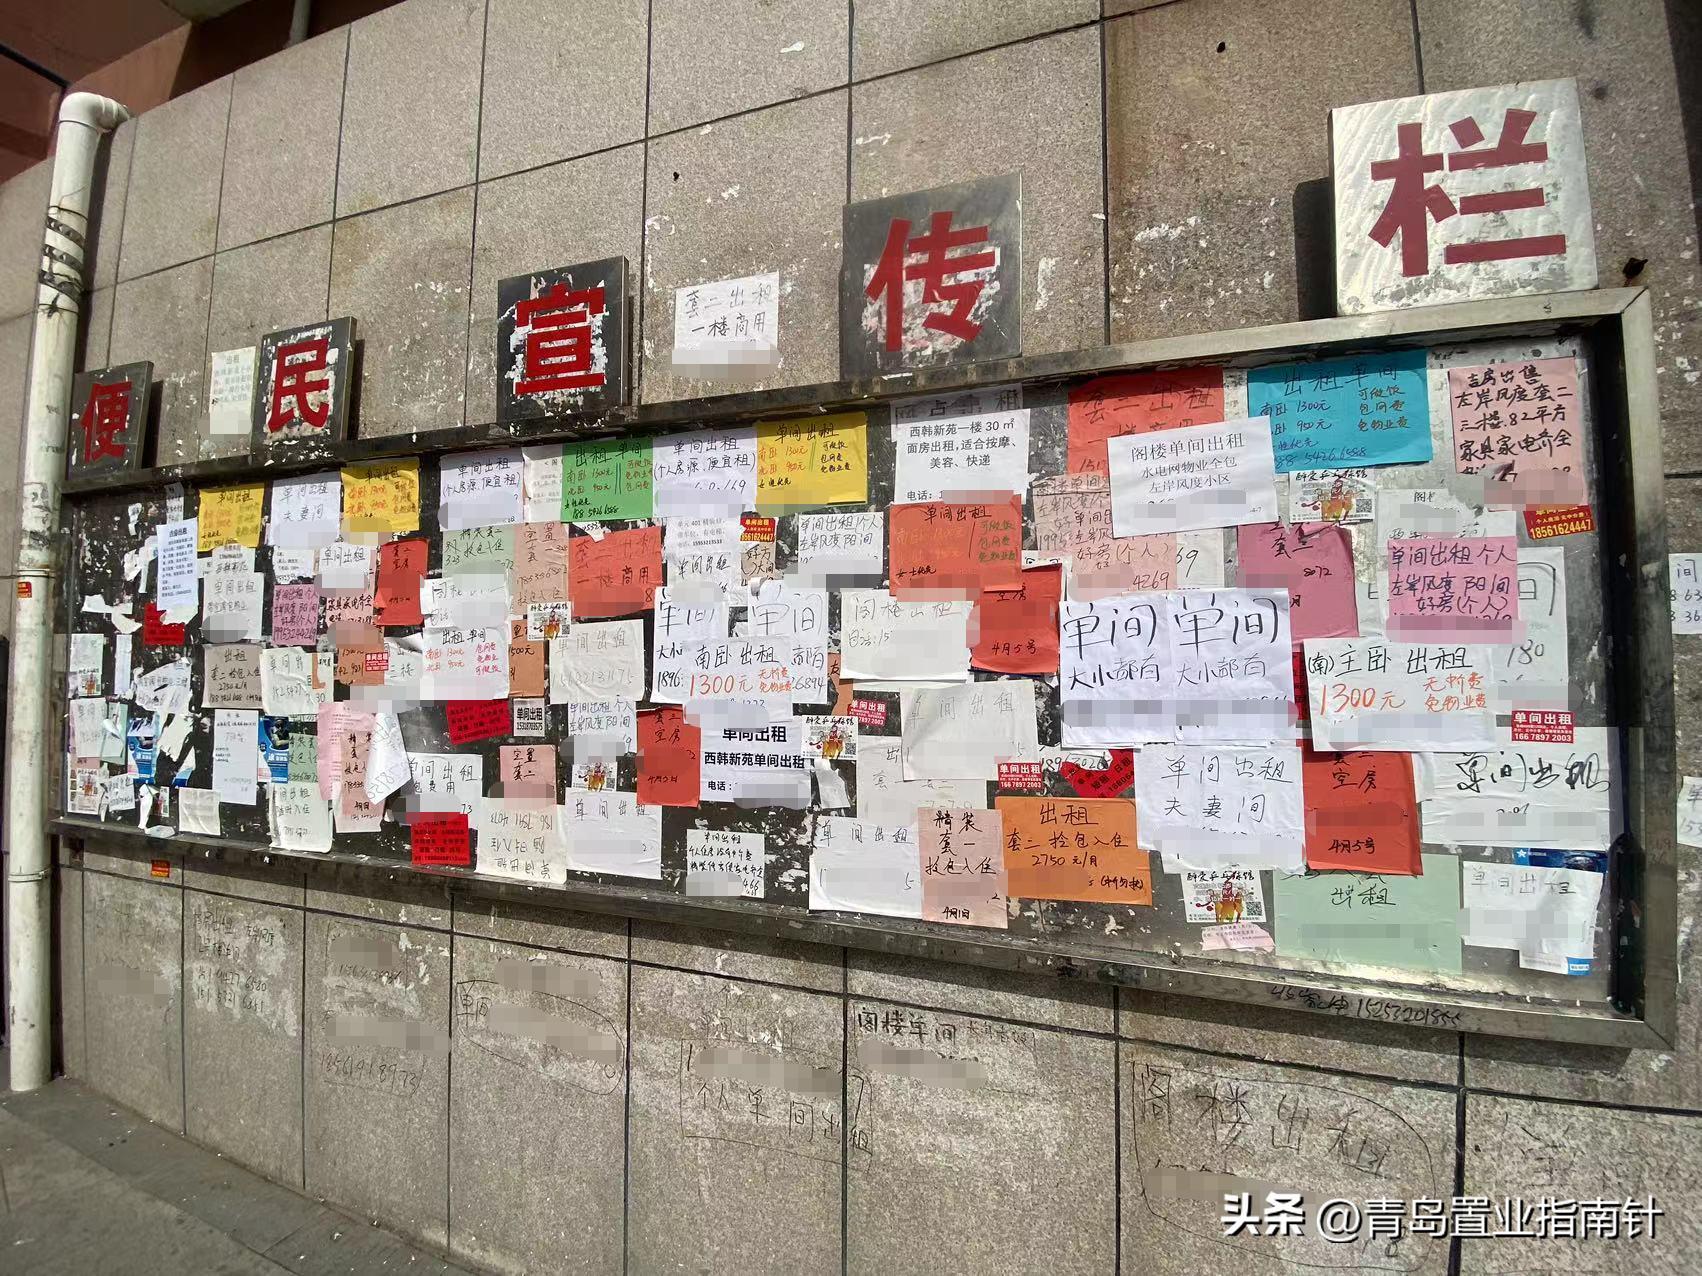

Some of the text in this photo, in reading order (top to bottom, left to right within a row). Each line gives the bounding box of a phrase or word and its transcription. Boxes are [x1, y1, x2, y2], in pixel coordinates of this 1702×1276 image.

[80, 108, 1566, 464] 便 民 宣 传 栏
[1284, 366, 1397, 397] 出租单间
[1467, 364, 1542, 388] 吉房出售
[1455, 384, 1574, 411] 左岸风度套二
[775, 423, 840, 443] 单间出租
[910, 420, 1000, 438] 西韩新苑一楼 30
[1271, 422, 1287, 436] 卧
[673, 437, 740, 455] 单间出租
[1131, 432, 1246, 462] 阁楼单间出租
[1459, 428, 1572, 462] 家具家电齐全
[457, 457, 511, 476] 单间出租
[1142, 455, 1238, 479] 水电网物业全包
[1150, 472, 1231, 494] 左岸风度小区
[924, 505, 992, 524] 单间出租
[1530, 519, 1592, 539] 18561624447
[1391, 541, 1517, 571] 单间出租 个人
[1677, 559, 1697, 582] 间
[1391, 572, 1511, 597] 左岸风度 阳间
[1062, 592, 1279, 661] 单间 单间
[695, 644, 781, 670] 南卧出租
[689, 673, 753, 698] 1300元
[851, 699, 887, 712] 单间出租
[1320, 684, 1405, 716] 1300元
[517, 707, 543, 720] 单间出租
[1514, 712, 1573, 726] 单间出租
[722, 727, 788, 743] 单间出租
[1514, 732, 1573, 743] 166 7897 2003
[704, 751, 806, 770] 西韩新苑单间出租
[1000, 764, 1041, 774] 单间出租
[1161, 755, 1294, 789] 单间出租
[1331, 771, 1378, 793] 空房
[1039, 803, 1098, 826] 出租
[1164, 795, 1266, 824] 夫妻间
[1470, 870, 1577, 896] 单间出租
